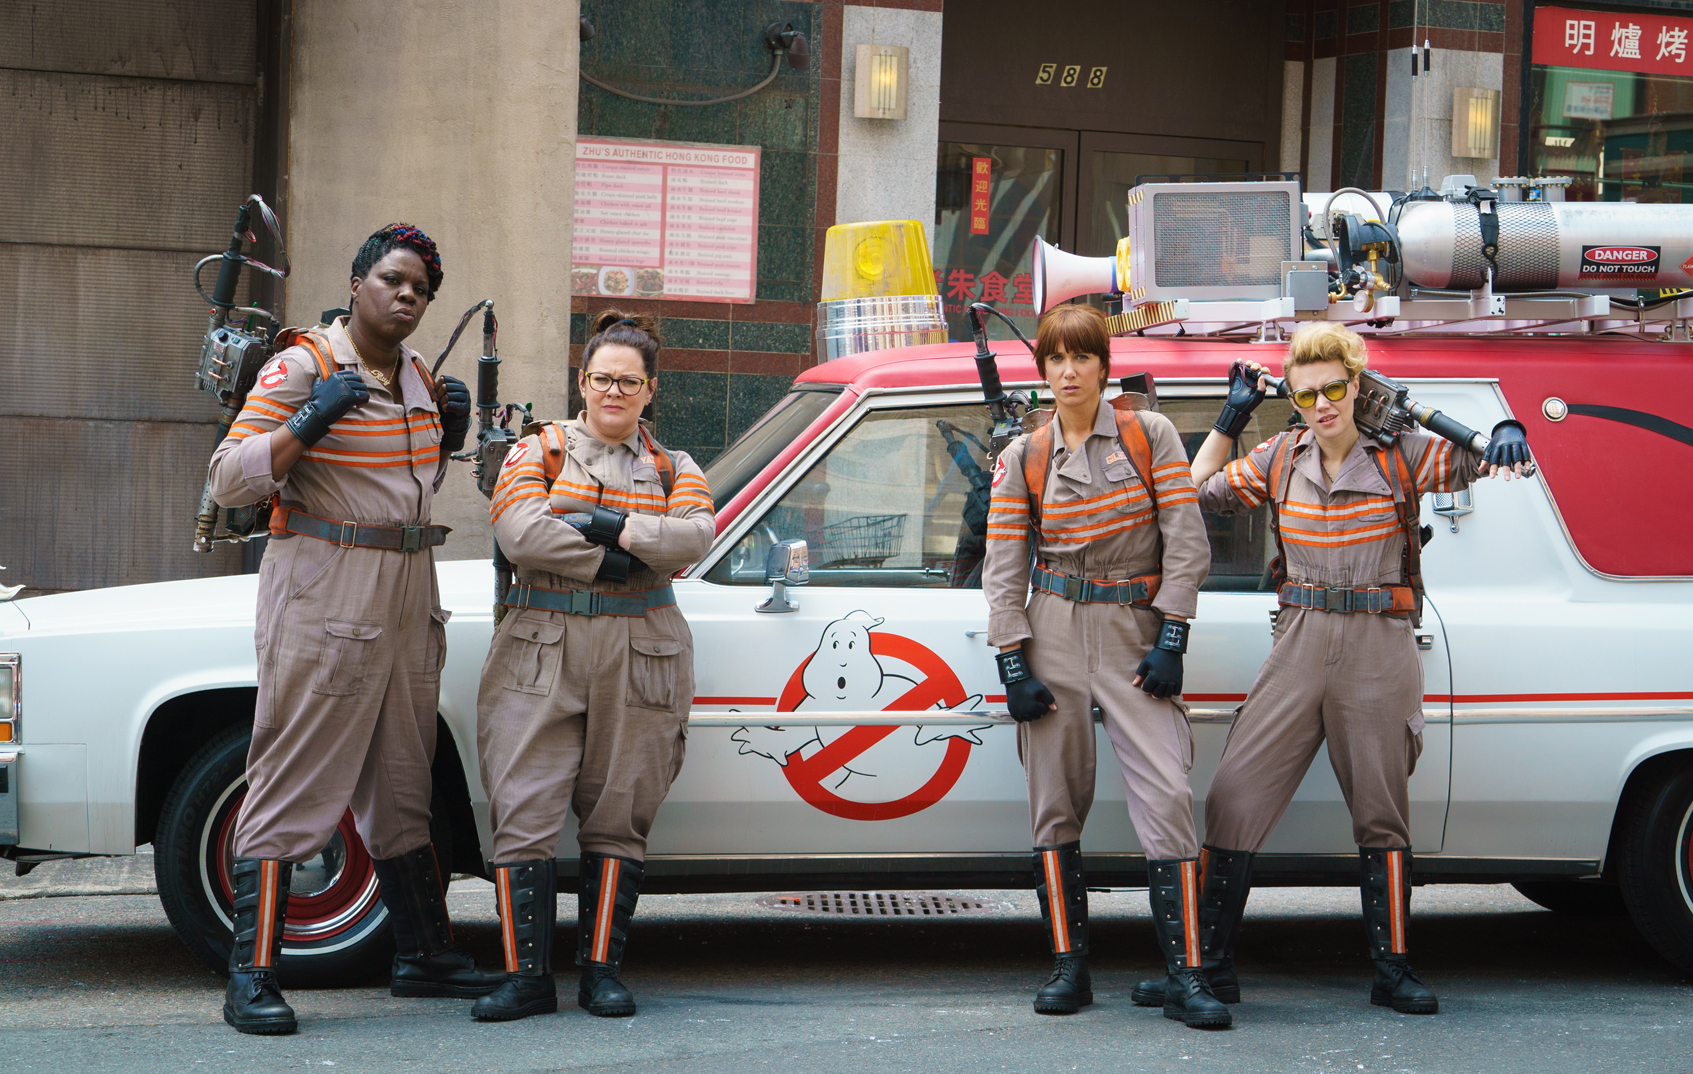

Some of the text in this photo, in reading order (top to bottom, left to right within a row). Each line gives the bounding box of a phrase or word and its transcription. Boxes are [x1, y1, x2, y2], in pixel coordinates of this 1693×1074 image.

[1565, 20, 1688, 63] 明爐烤
[1039, 65, 1104, 87] 588
[583, 147, 748, 165] ZHU'S AUTHENTIC HONG KONG FOOD
[974, 162, 989, 230] 歡迎光臨
[1595, 251, 1648, 260] DANGER
